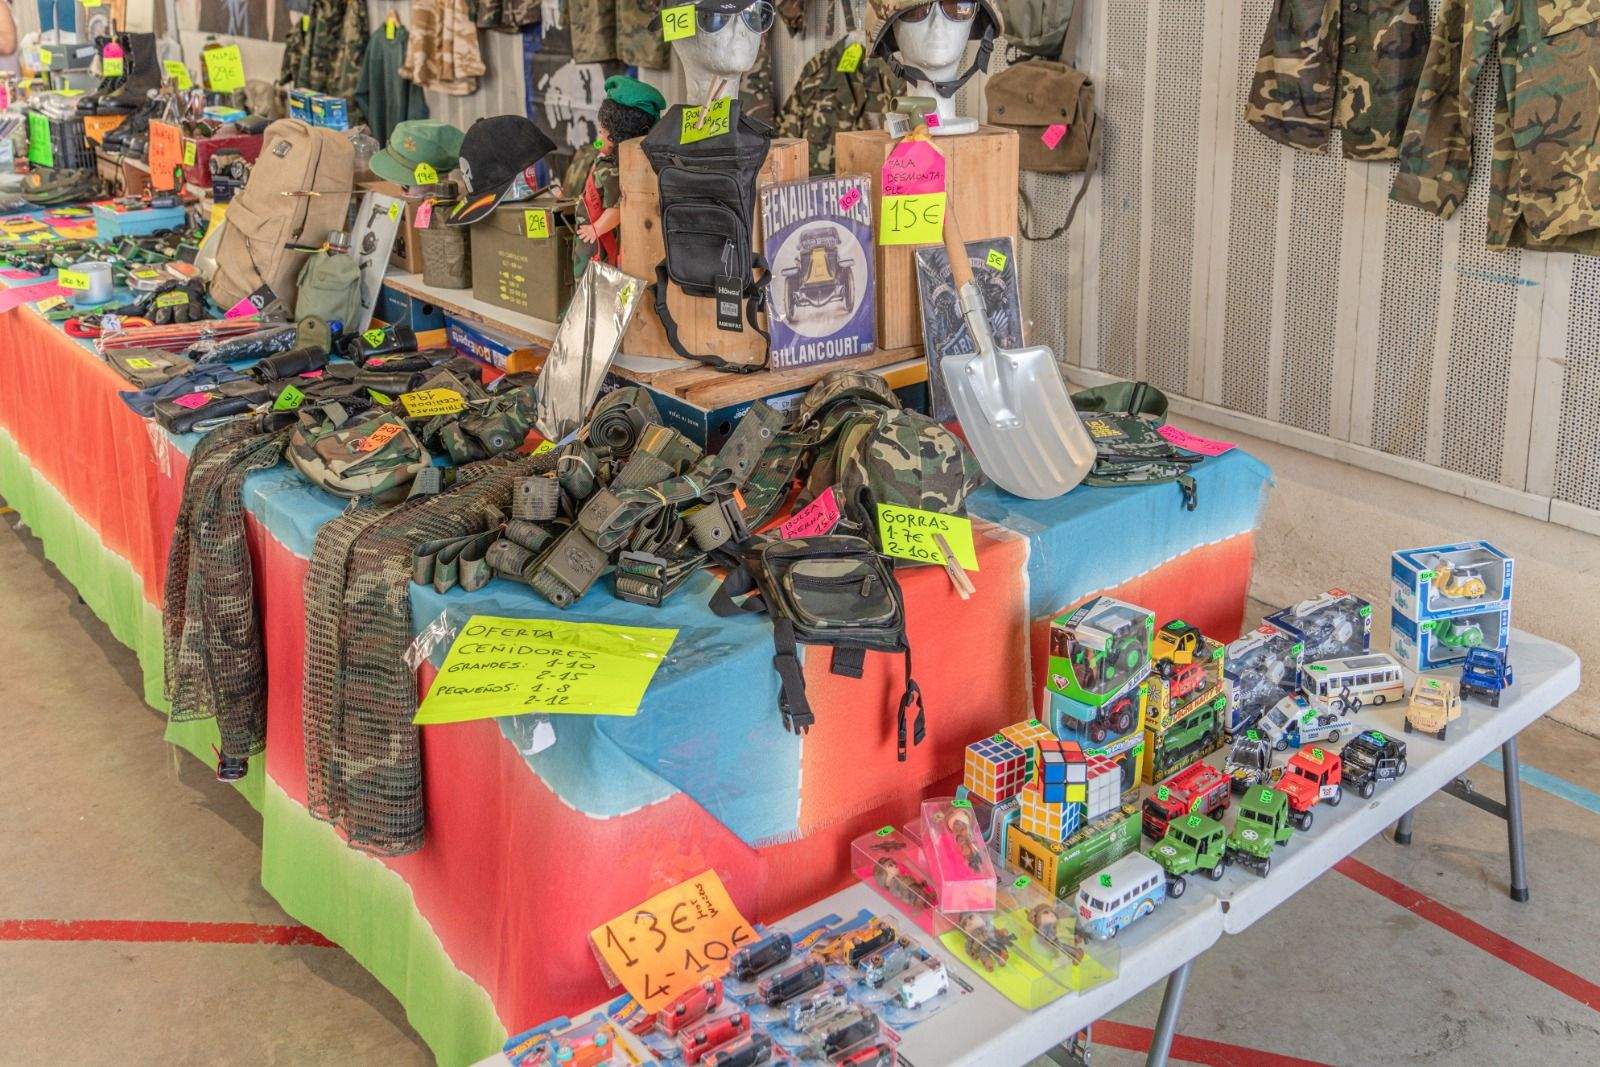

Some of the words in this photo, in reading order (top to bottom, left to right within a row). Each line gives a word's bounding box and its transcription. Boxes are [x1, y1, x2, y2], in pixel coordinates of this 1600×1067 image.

[665, 13, 688, 32] 9€
[763, 184, 818, 237] RENAULT
[889, 199, 940, 232] 15€
[528, 213, 545, 232] 29€
[772, 335, 859, 368] BILLANCOURT
[408, 391, 435, 402] 19€
[785, 503, 819, 530] BOLSA
[814, 513, 836, 534] 15€
[881, 510, 949, 532] GORRAS
[466, 625, 554, 640] OFERTA
